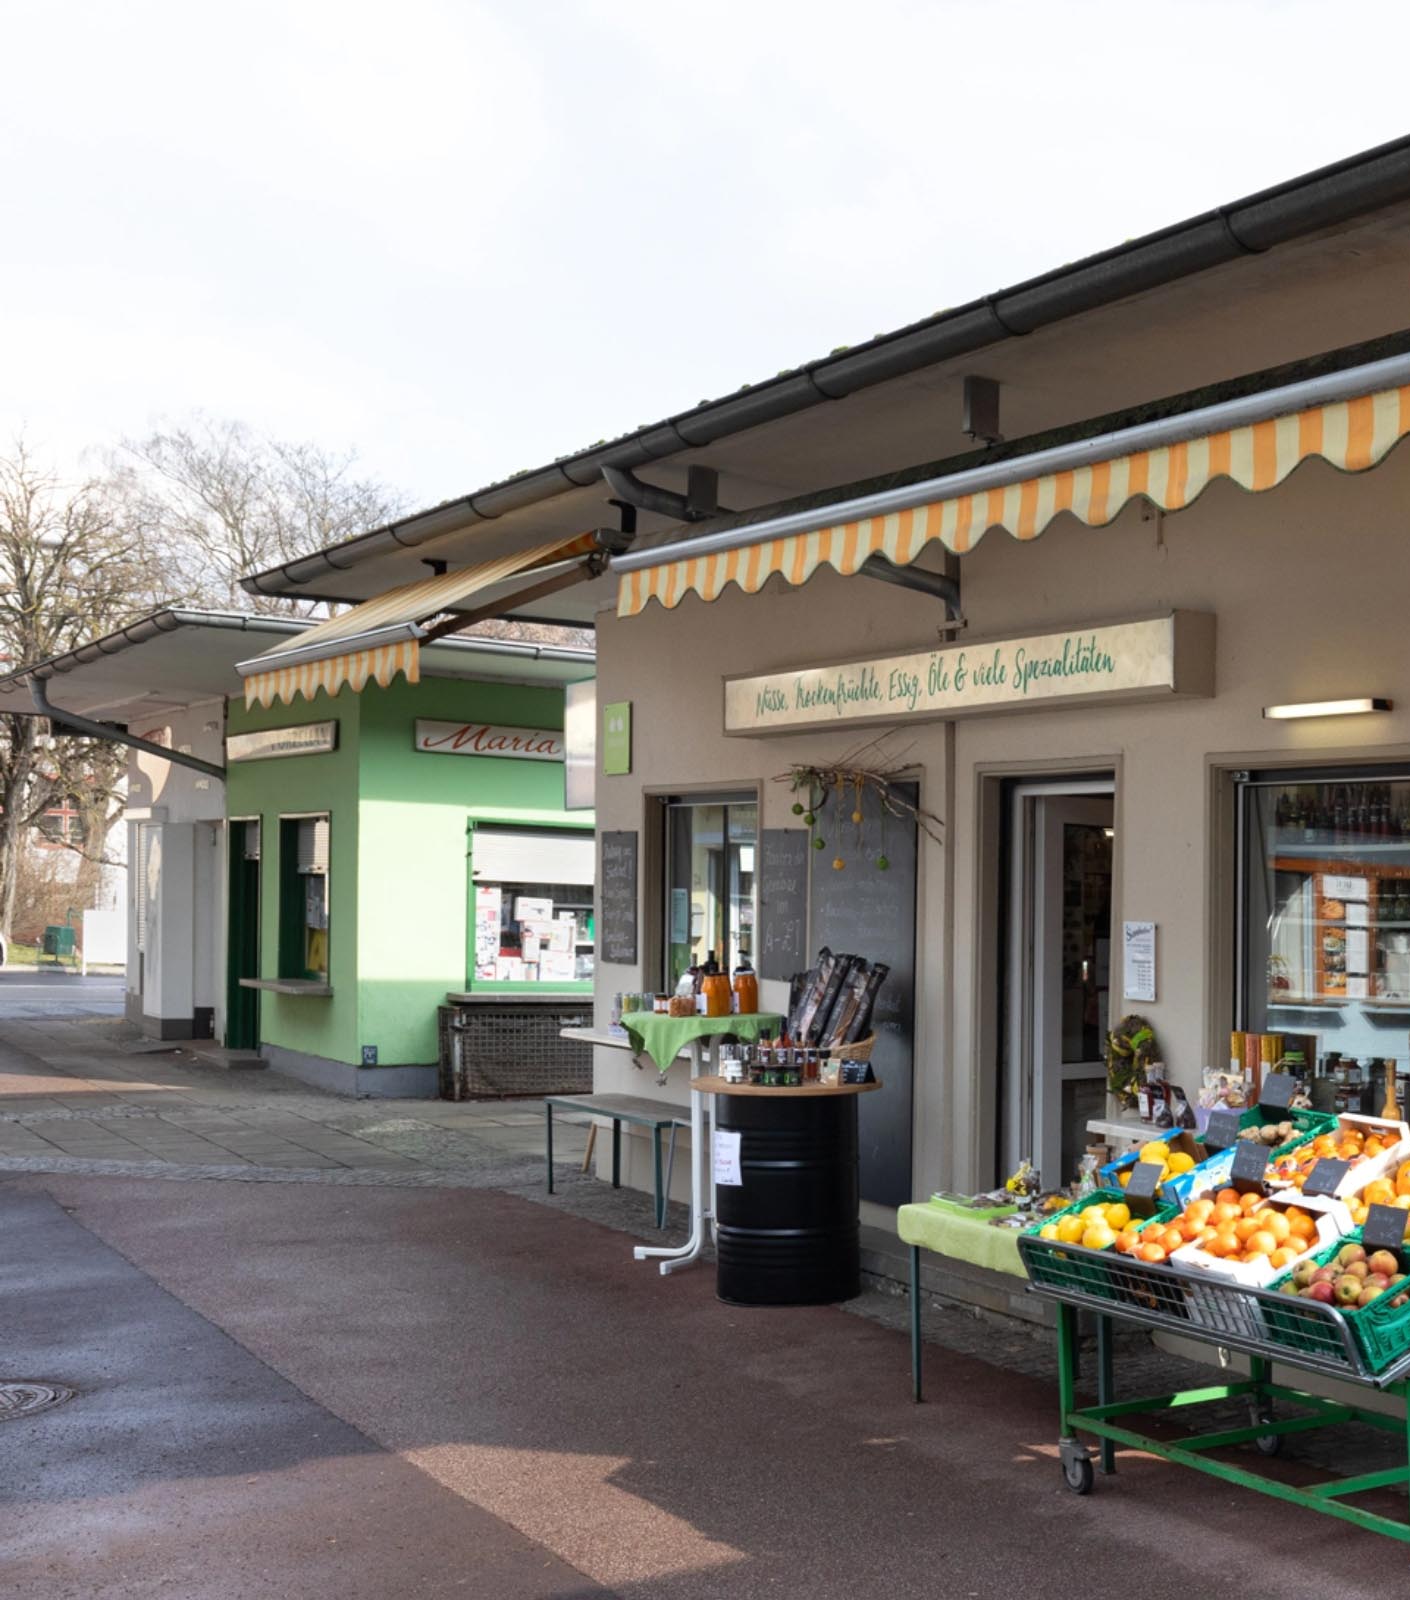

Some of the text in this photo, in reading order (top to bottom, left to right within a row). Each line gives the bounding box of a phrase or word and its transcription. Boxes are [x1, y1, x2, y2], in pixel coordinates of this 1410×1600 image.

[928, 653, 950, 696] Öle
[954, 652, 968, 692] &
[973, 648, 1007, 686] viele
[1013, 635, 1116, 694] Spezialitäten
[423, 724, 562, 754] Maria
